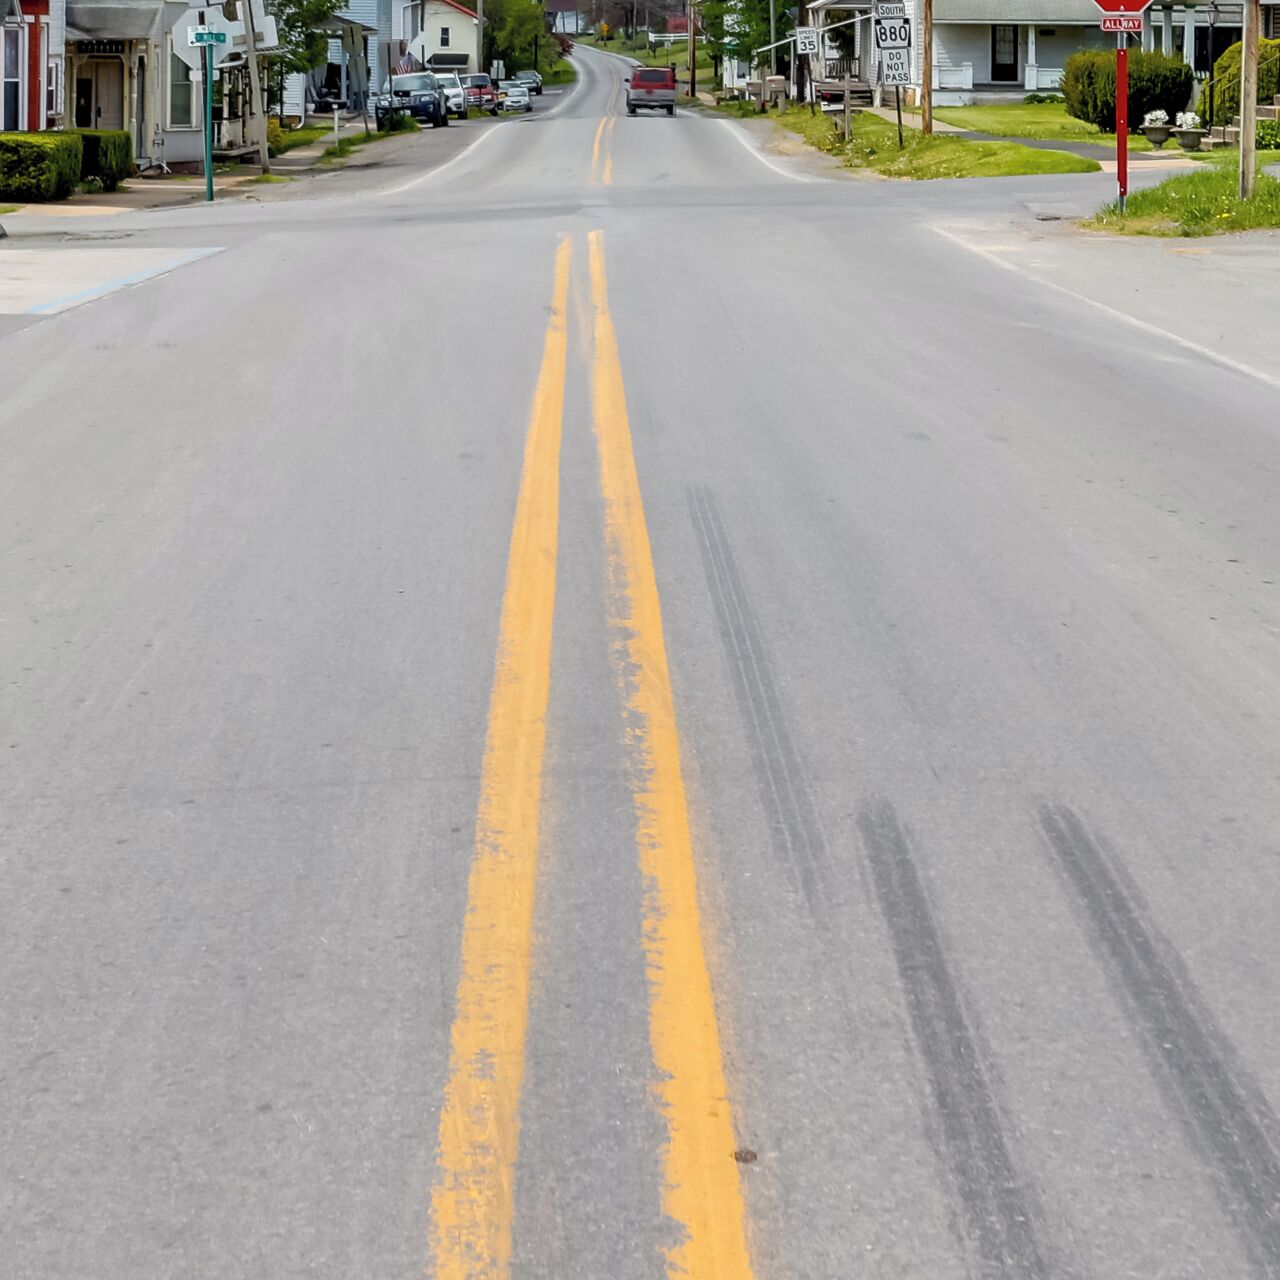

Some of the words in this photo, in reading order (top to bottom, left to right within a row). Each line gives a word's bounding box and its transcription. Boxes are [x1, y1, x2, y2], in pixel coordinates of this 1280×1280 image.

[880, 5, 904, 16] SOUTH
[879, 25, 908, 42] 880
[800, 40, 816, 51] 35
[889, 52, 901, 60] DO
[886, 62, 904, 71] NOT
[885, 73, 909, 82] PASS
